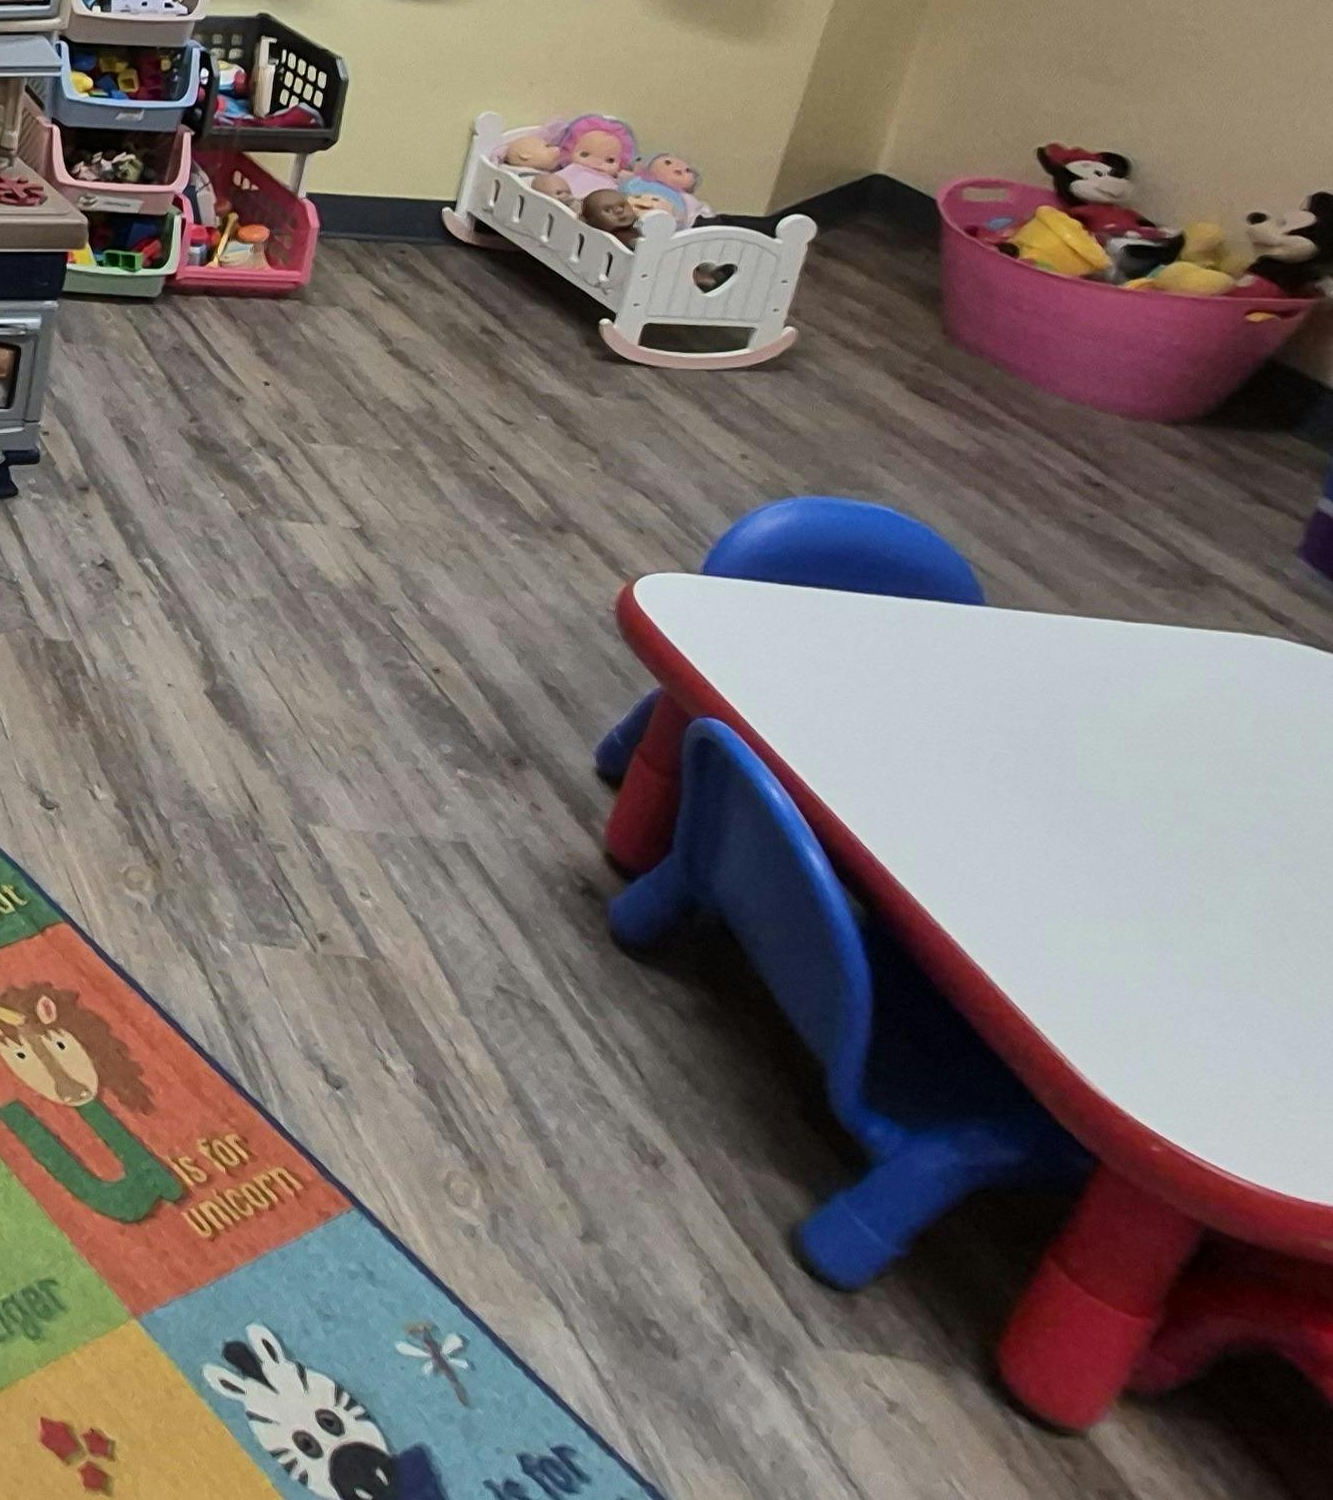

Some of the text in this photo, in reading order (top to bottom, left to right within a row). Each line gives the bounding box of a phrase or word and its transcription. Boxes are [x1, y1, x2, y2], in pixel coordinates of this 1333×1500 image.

[161, 1132, 253, 1186] is for
[180, 1165, 306, 1239] unicorn
